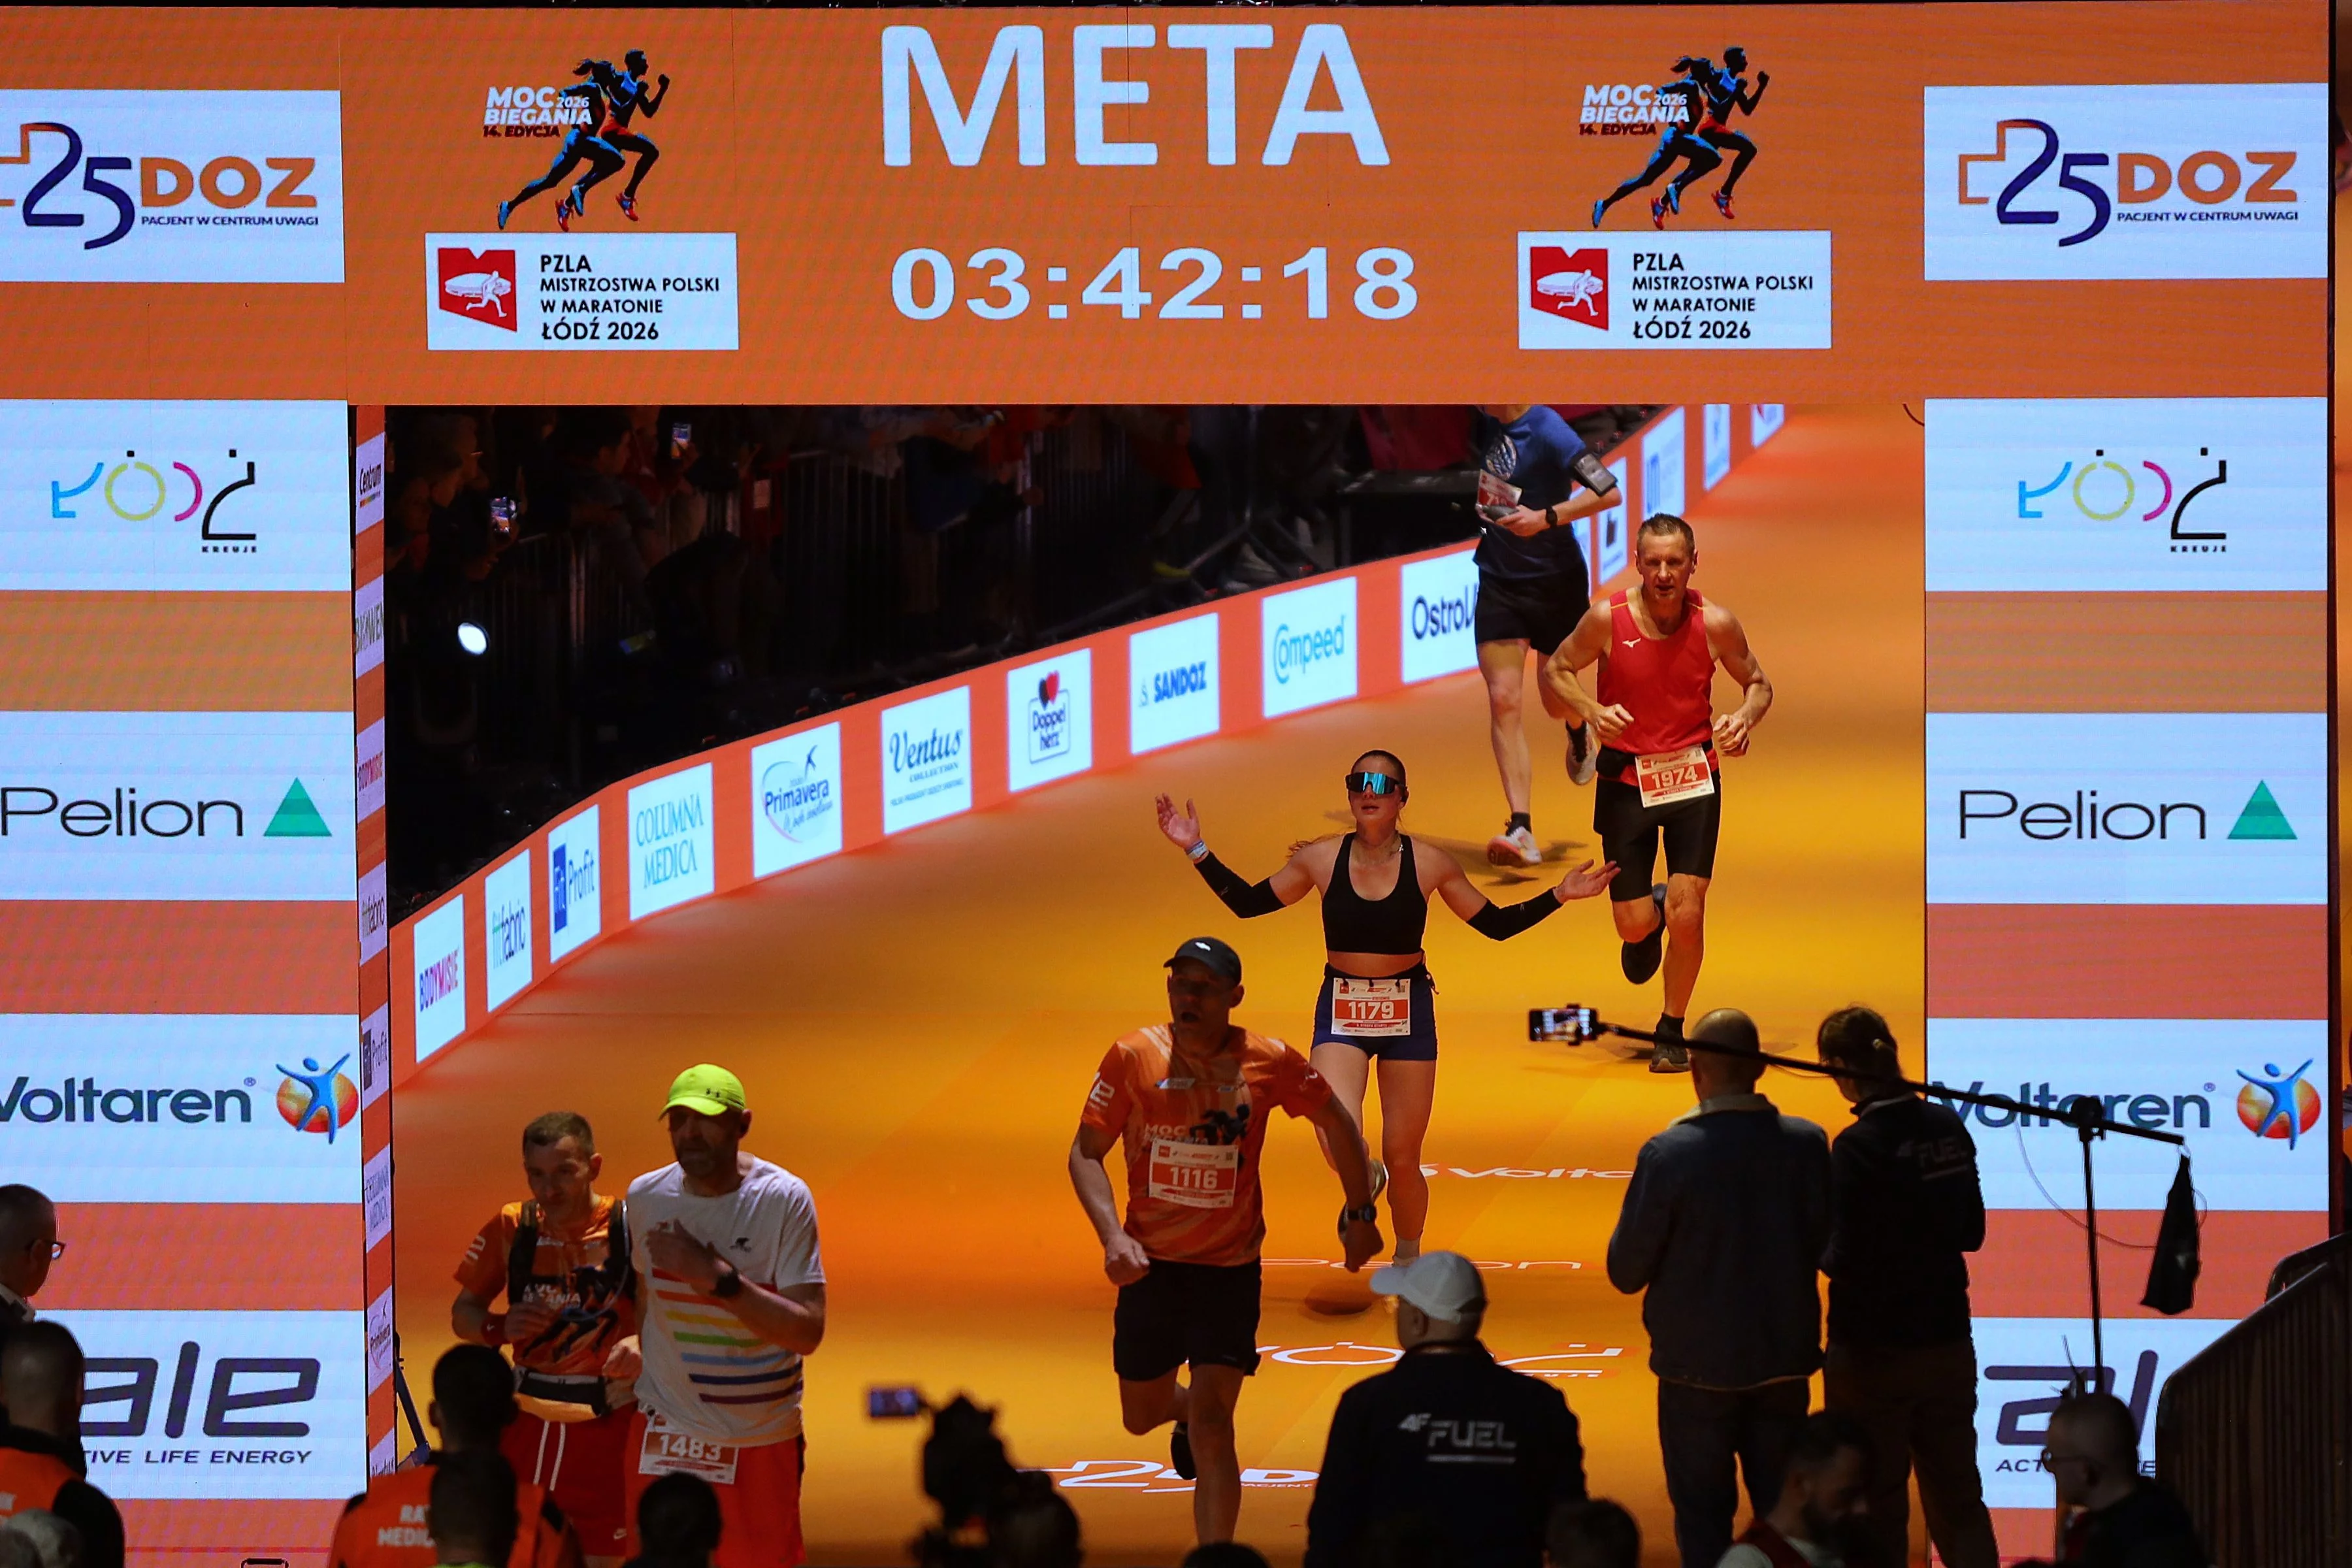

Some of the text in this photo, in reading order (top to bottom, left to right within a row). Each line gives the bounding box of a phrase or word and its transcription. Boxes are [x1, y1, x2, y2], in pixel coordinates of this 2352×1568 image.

[486, 86, 590, 108] MOC 2026
[881, 24, 1391, 167] META
[1582, 84, 1688, 106] MOC 2026
[484, 108, 593, 125] BIEGANIA
[1580, 106, 1690, 123] BIEGANIA
[505, 125, 561, 138] EDYCJA
[1601, 123, 1657, 135] EDYCJA
[140, 156, 318, 209] DOZ
[2117, 150, 2298, 204] DOZ
[141, 216, 319, 227] PACJENT W CENTRUM UWAGI
[2117, 211, 2298, 222] PACJENT W CENTRUM UWAGI
[540, 255, 592, 273] PZLA
[1633, 253, 1684, 271] PZLA
[540, 277, 720, 292] MISTRZOSTWA POLSKI
[891, 246, 1418, 321] 03:42:18
[1633, 276, 1813, 290] MISTRZOSTWA POLSKI
[541, 299, 663, 314] W MARATONIE
[1633, 298, 1756, 312] W MARATONIE
[542, 318, 659, 340] ŁÓDŹ 2026
[1633, 316, 1751, 339] ŁÓDŹ 2026
[359, 463, 382, 495] Centrum
[1412, 583, 1478, 640] OstroV
[1274, 614, 1345, 685] Compeed
[1153, 661, 1207, 703] SANDOZ
[889, 727, 963, 774] Ventus
[1652, 765, 1698, 789] 1974
[765, 779, 828, 816] Primavera
[1, 787, 243, 837] Pelion
[636, 791, 704, 847] COLUMNA
[1960, 790, 2206, 840] Pelion
[644, 839, 698, 889] MEDICA
[1348, 1001, 1394, 1020] 1179
[1170, 1166, 1218, 1190] 1116
[1428, 1420, 1517, 1449] FUEL
[144, 1450, 200, 1463] LIFE
[210, 1450, 312, 1463] ENERGY
[660, 1434, 721, 1462] 1483
